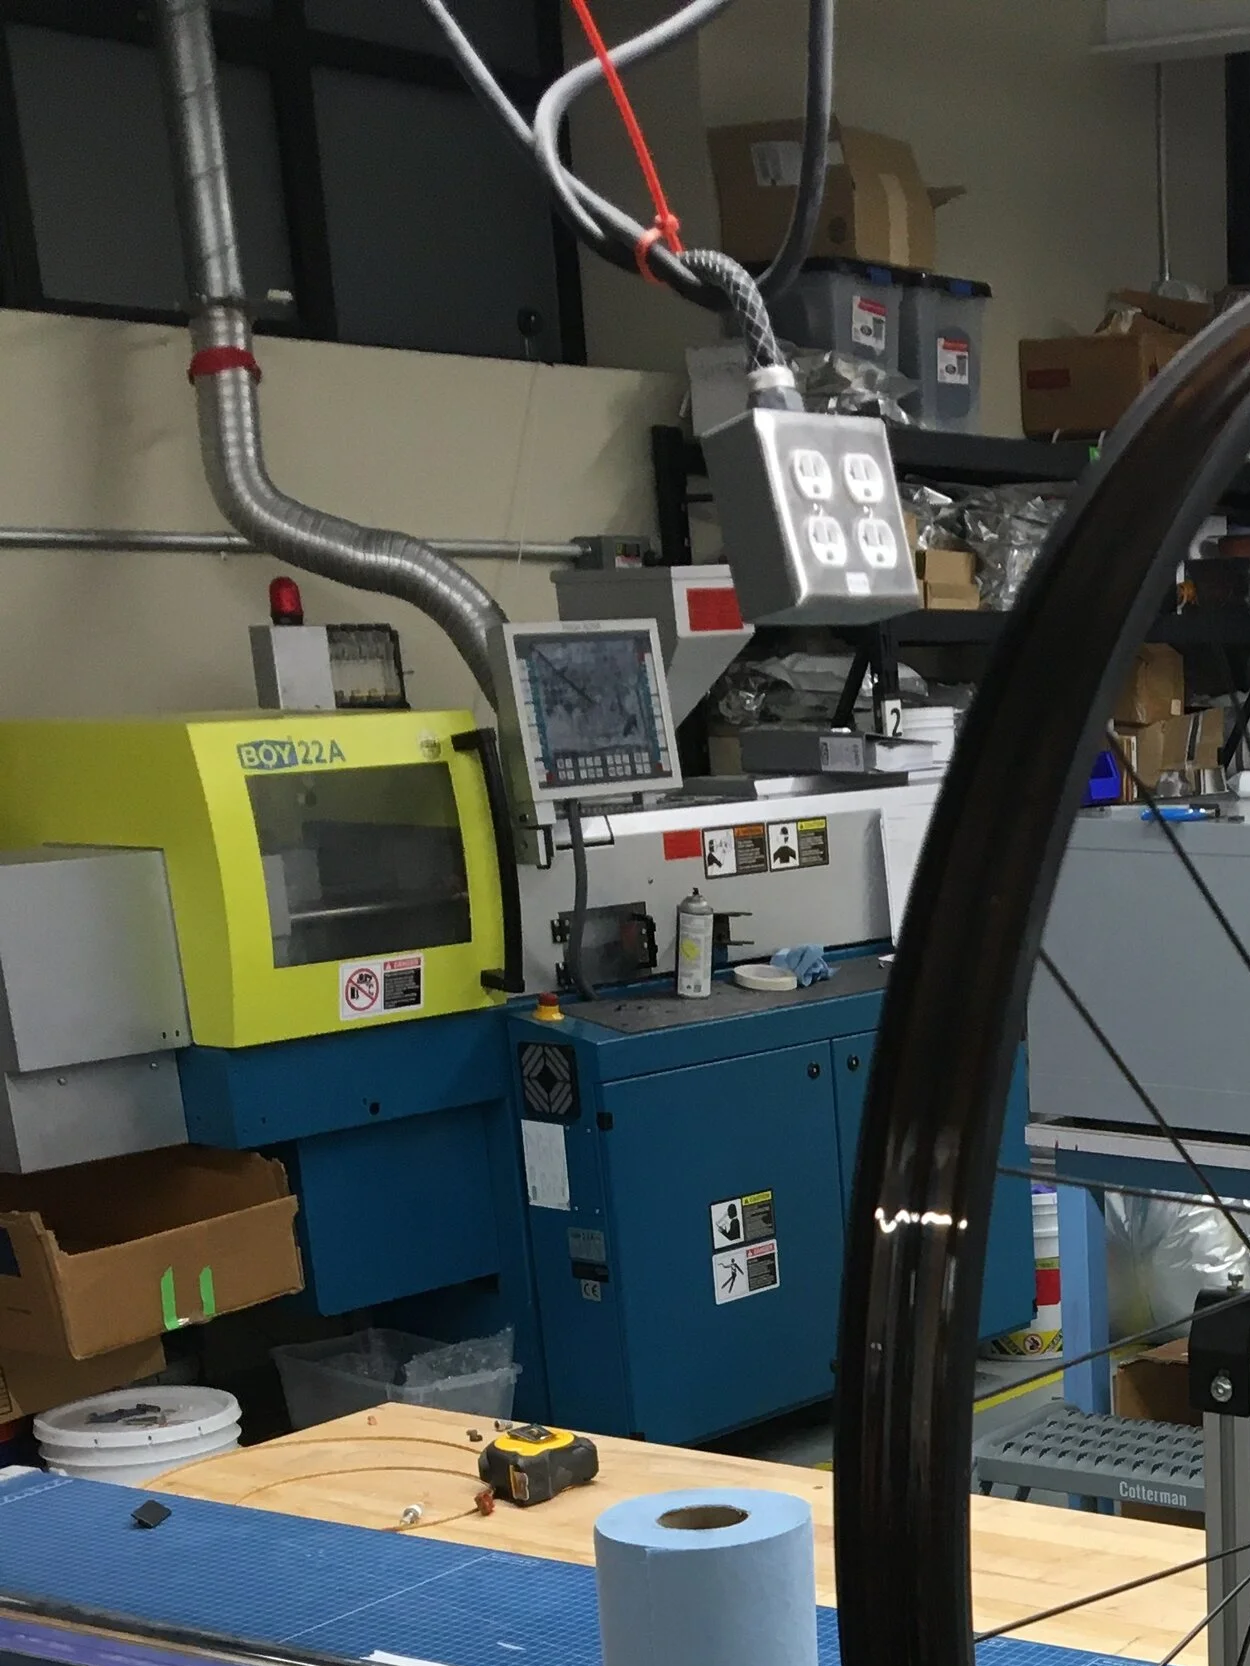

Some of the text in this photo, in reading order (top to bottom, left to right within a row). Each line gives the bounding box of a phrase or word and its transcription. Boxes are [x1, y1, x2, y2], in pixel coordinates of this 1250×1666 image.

[238, 739, 346, 769] BOY 22A
[1119, 1480, 1187, 1507] Cotterman
